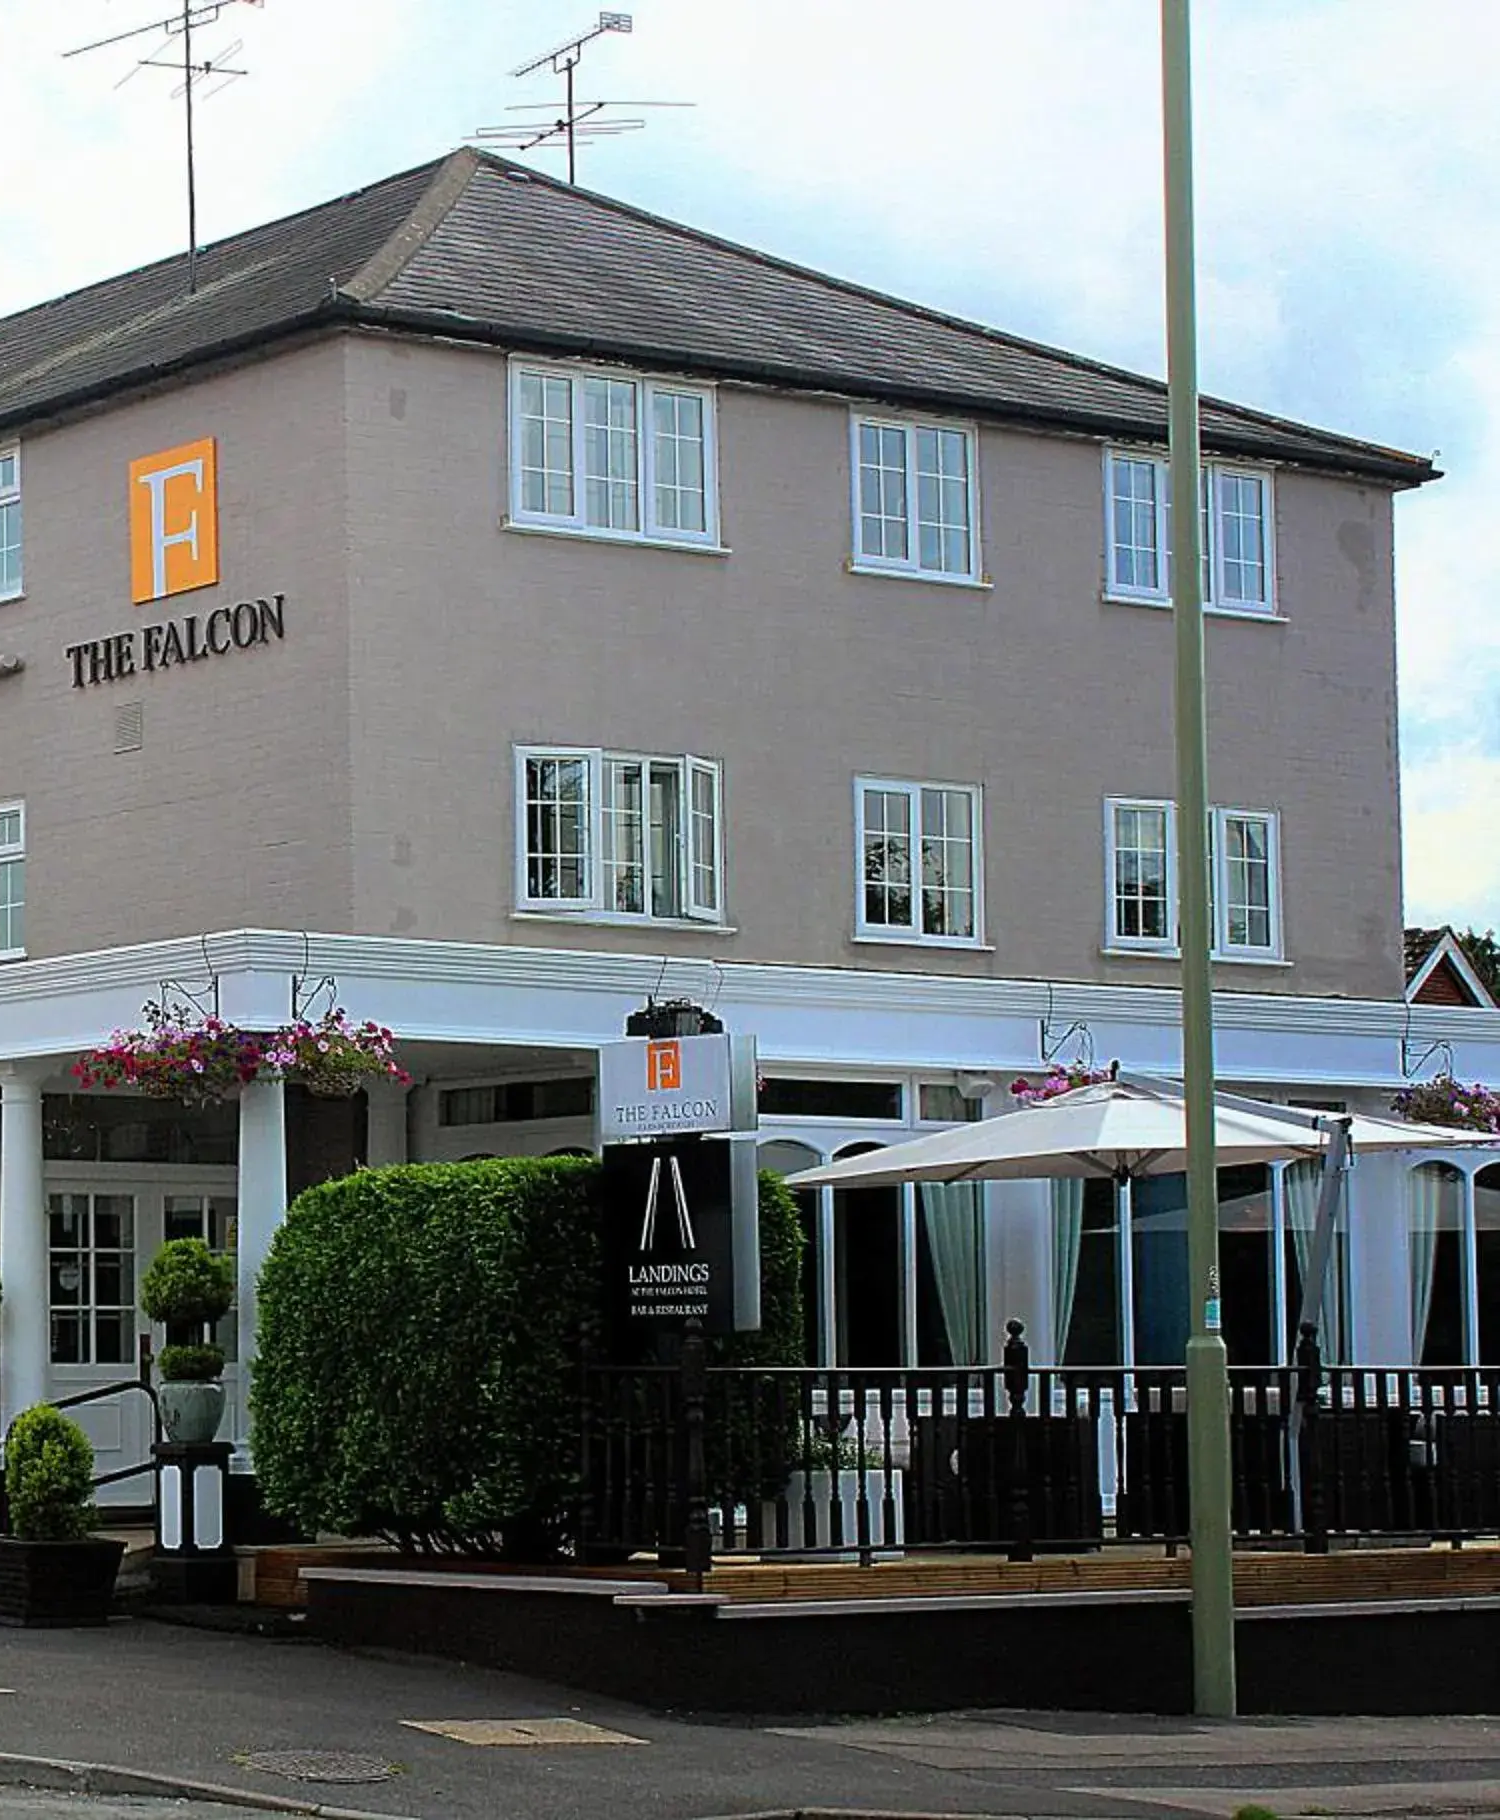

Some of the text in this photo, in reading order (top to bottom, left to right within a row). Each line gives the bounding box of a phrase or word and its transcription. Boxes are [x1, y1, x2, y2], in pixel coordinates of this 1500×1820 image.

[138, 458, 204, 599] F
[65, 592, 286, 689] THE FALCON
[615, 1099, 717, 1123] THE FALCON
[628, 1263, 709, 1283] LANDINGS
